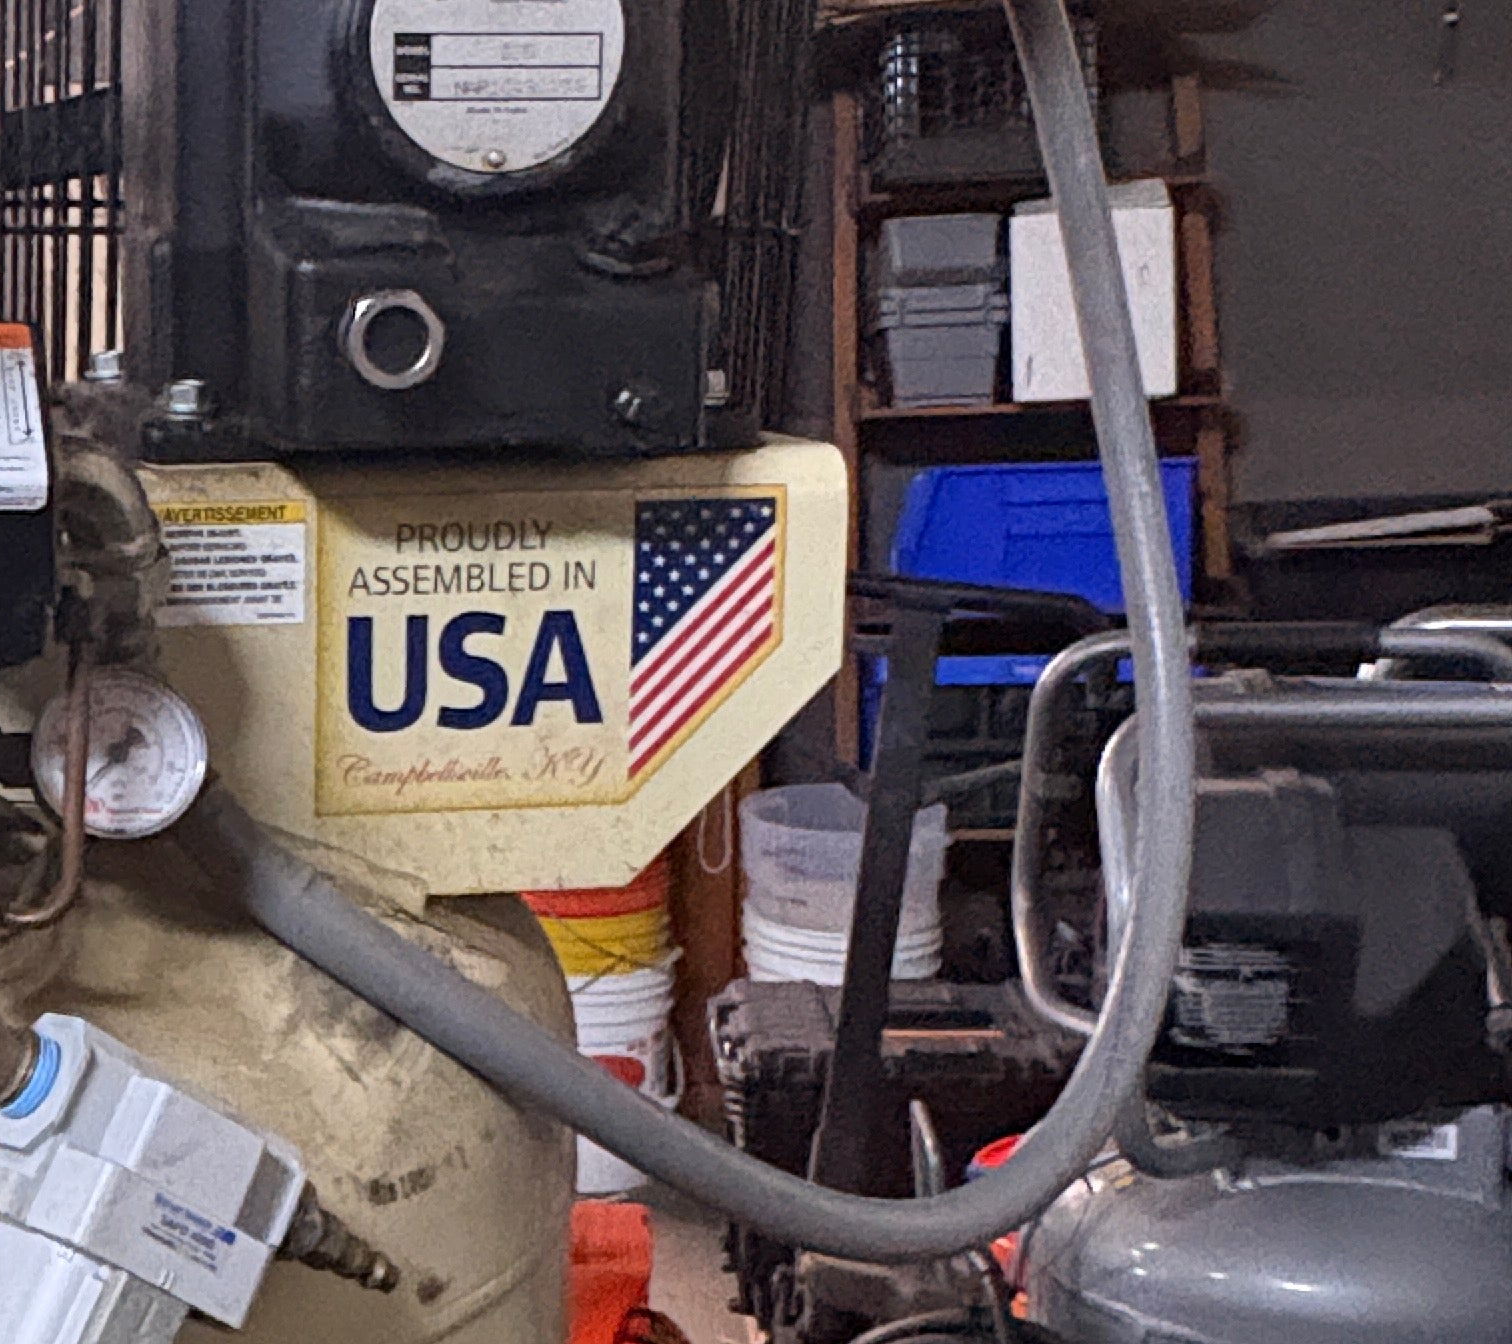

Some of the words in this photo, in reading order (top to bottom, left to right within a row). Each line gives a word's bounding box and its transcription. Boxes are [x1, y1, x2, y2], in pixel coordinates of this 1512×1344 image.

[164, 505, 286, 522] AVERTISSEMENT
[396, 520, 553, 553] PROUDLY
[348, 562, 550, 597] ASSEMBLED
[564, 560, 596, 590] IN
[347, 610, 603, 732] USA
